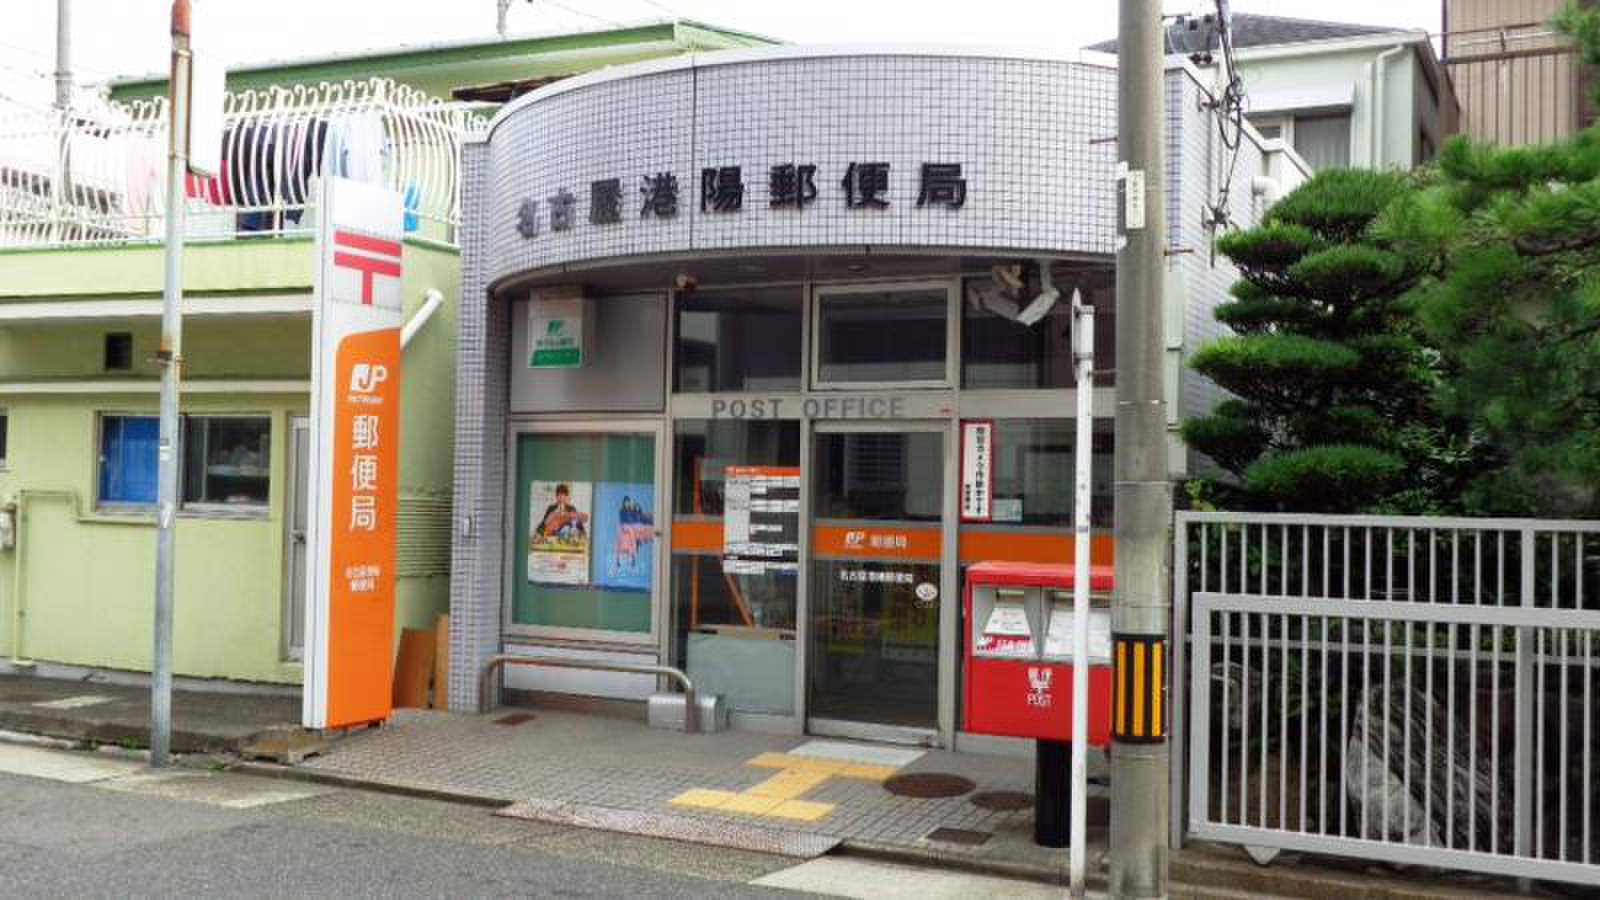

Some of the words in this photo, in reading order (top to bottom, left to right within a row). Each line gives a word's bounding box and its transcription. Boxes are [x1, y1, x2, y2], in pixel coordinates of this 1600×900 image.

[516, 161, 967, 239] 名古屋港陽郵便局
[711, 399, 784, 417] POST
[803, 398, 905, 417] OFFICE
[350, 415, 379, 531] 郵便局
[1027, 693, 1052, 707] POST
